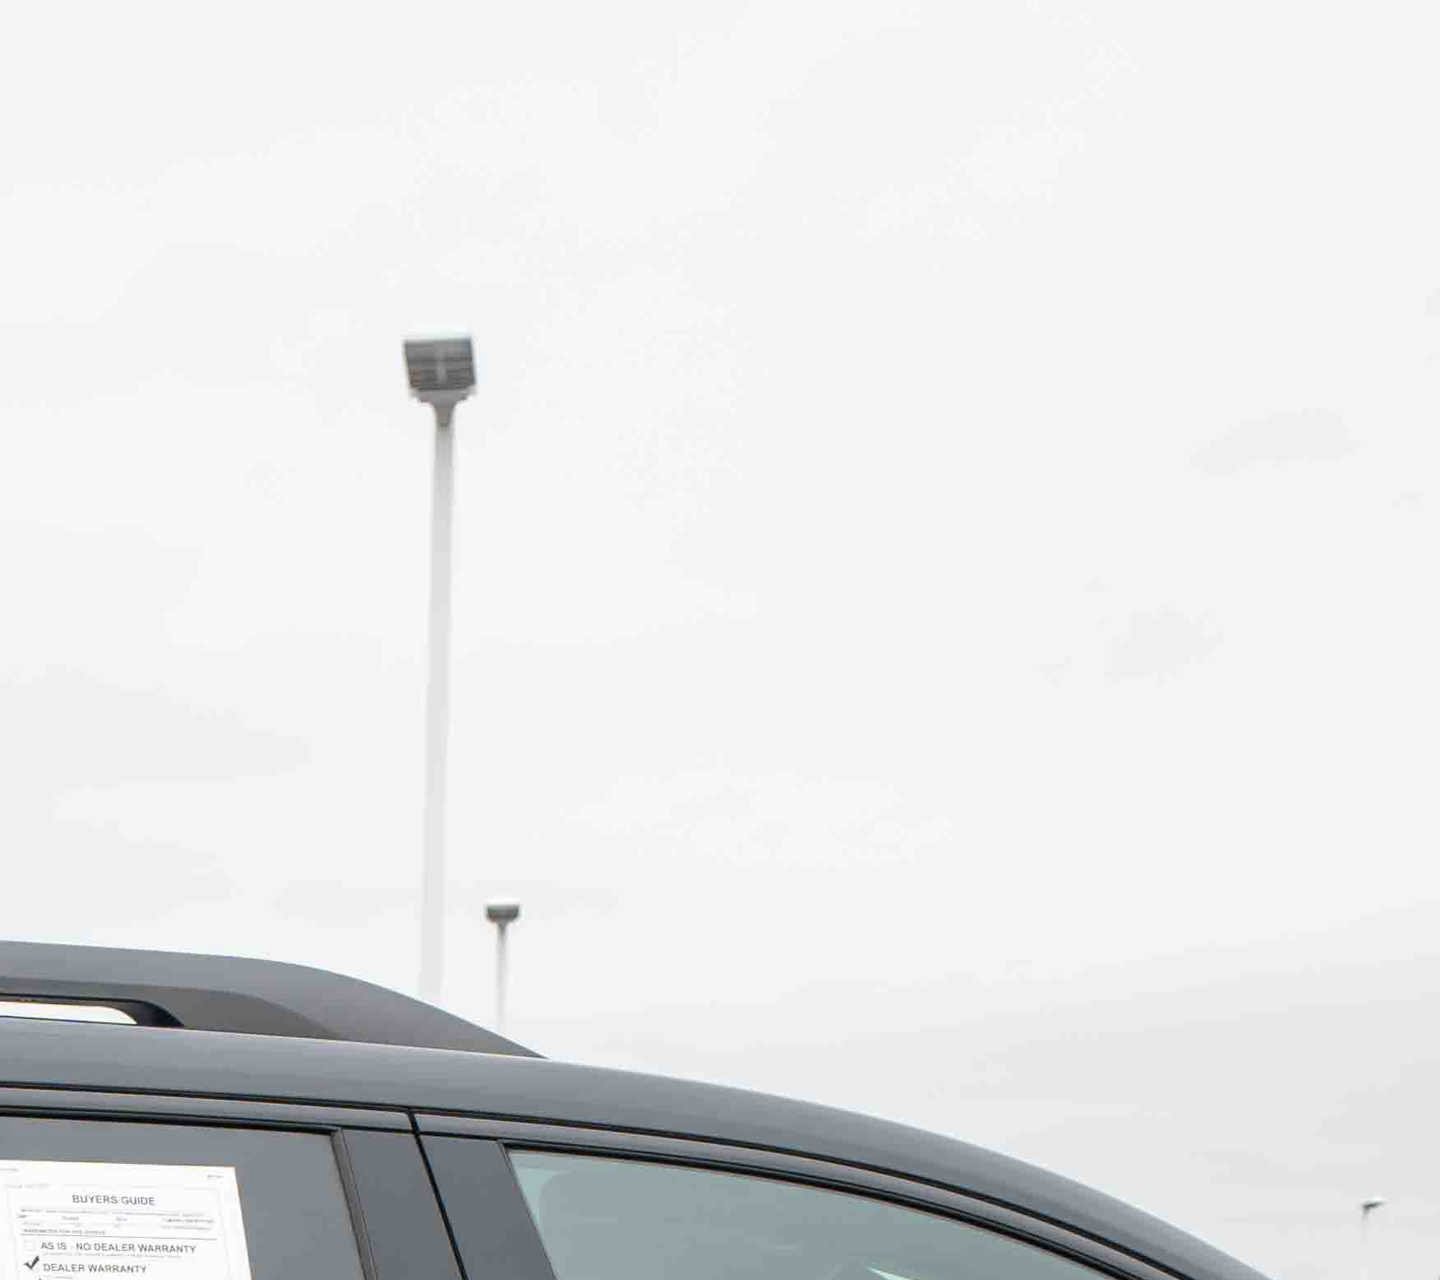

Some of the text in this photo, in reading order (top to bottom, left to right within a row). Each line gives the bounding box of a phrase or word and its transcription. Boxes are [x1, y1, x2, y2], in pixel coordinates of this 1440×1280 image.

[72, 1194, 155, 1206] BUYERS GUIDE
[41, 1242, 197, 1254] AS IS NO DEALER WARRANTY
[43, 1263, 147, 1273] DEALER WARRANTY
